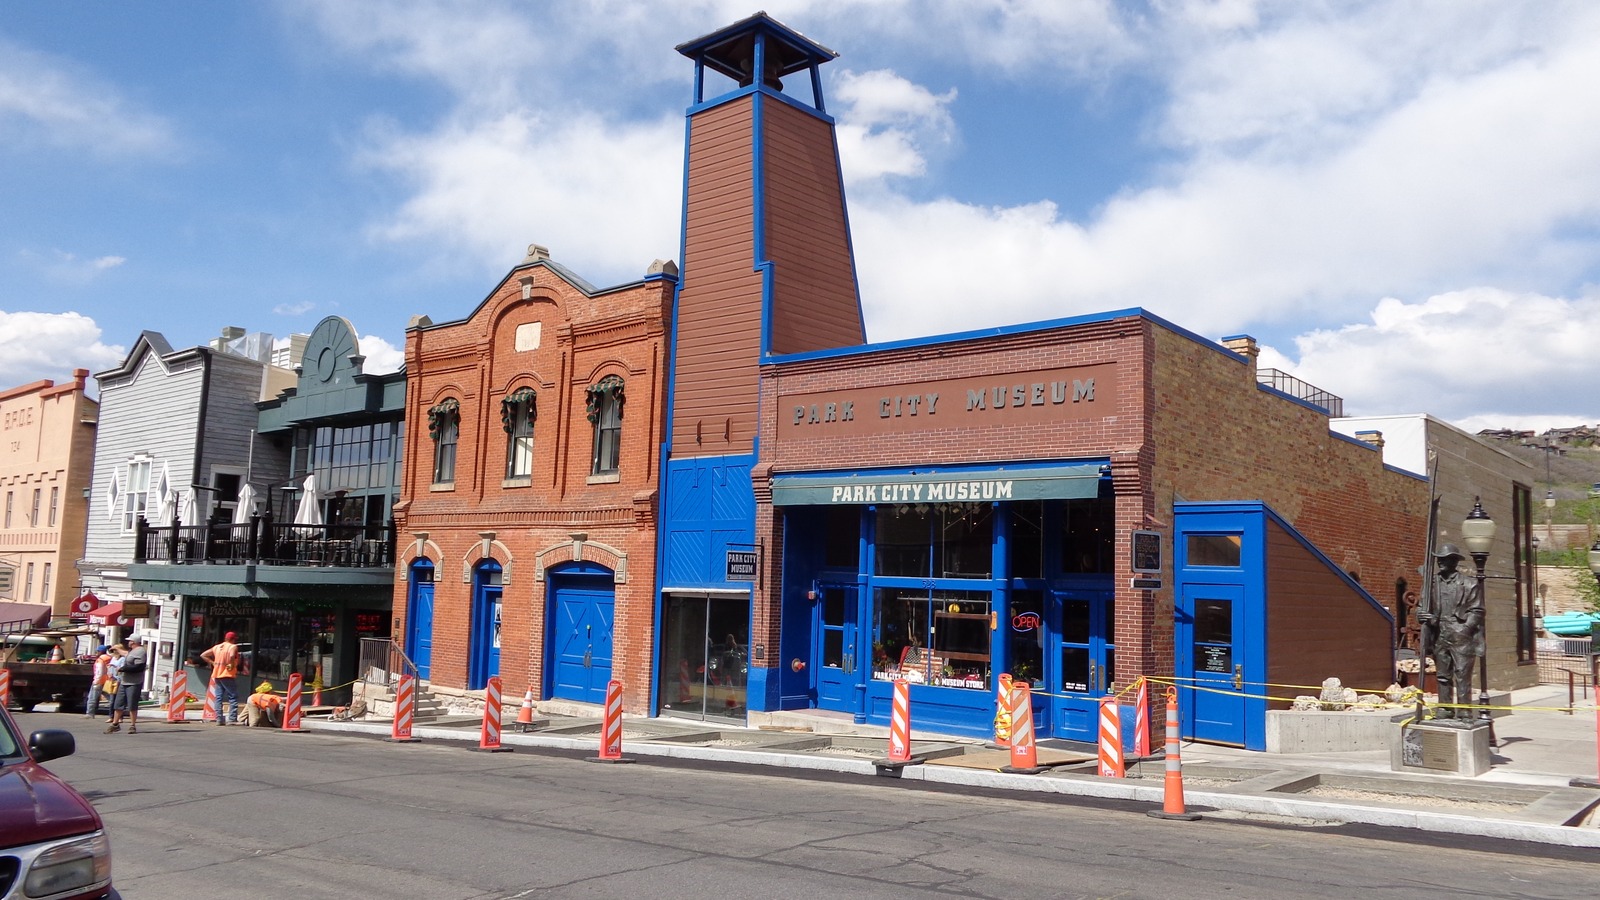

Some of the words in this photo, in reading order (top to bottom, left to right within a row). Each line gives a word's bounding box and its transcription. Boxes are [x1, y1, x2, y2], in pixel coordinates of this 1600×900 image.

[793, 401, 855, 425] PARK
[879, 392, 939, 418] CITY
[966, 378, 1096, 411] MUSEUM
[831, 485, 877, 502] PARK
[881, 483, 923, 501] CITY
[927, 481, 1013, 500] MUSEUM
[728, 553, 743, 563] PARK
[743, 554, 757, 563] CITY
[731, 564, 753, 574] MUSEUM
[1012, 616, 1040, 629] OPEN
[873, 671, 889, 680] PARK
[941, 678, 965, 688] MUSEUM
[965, 680, 984, 690] STORE
